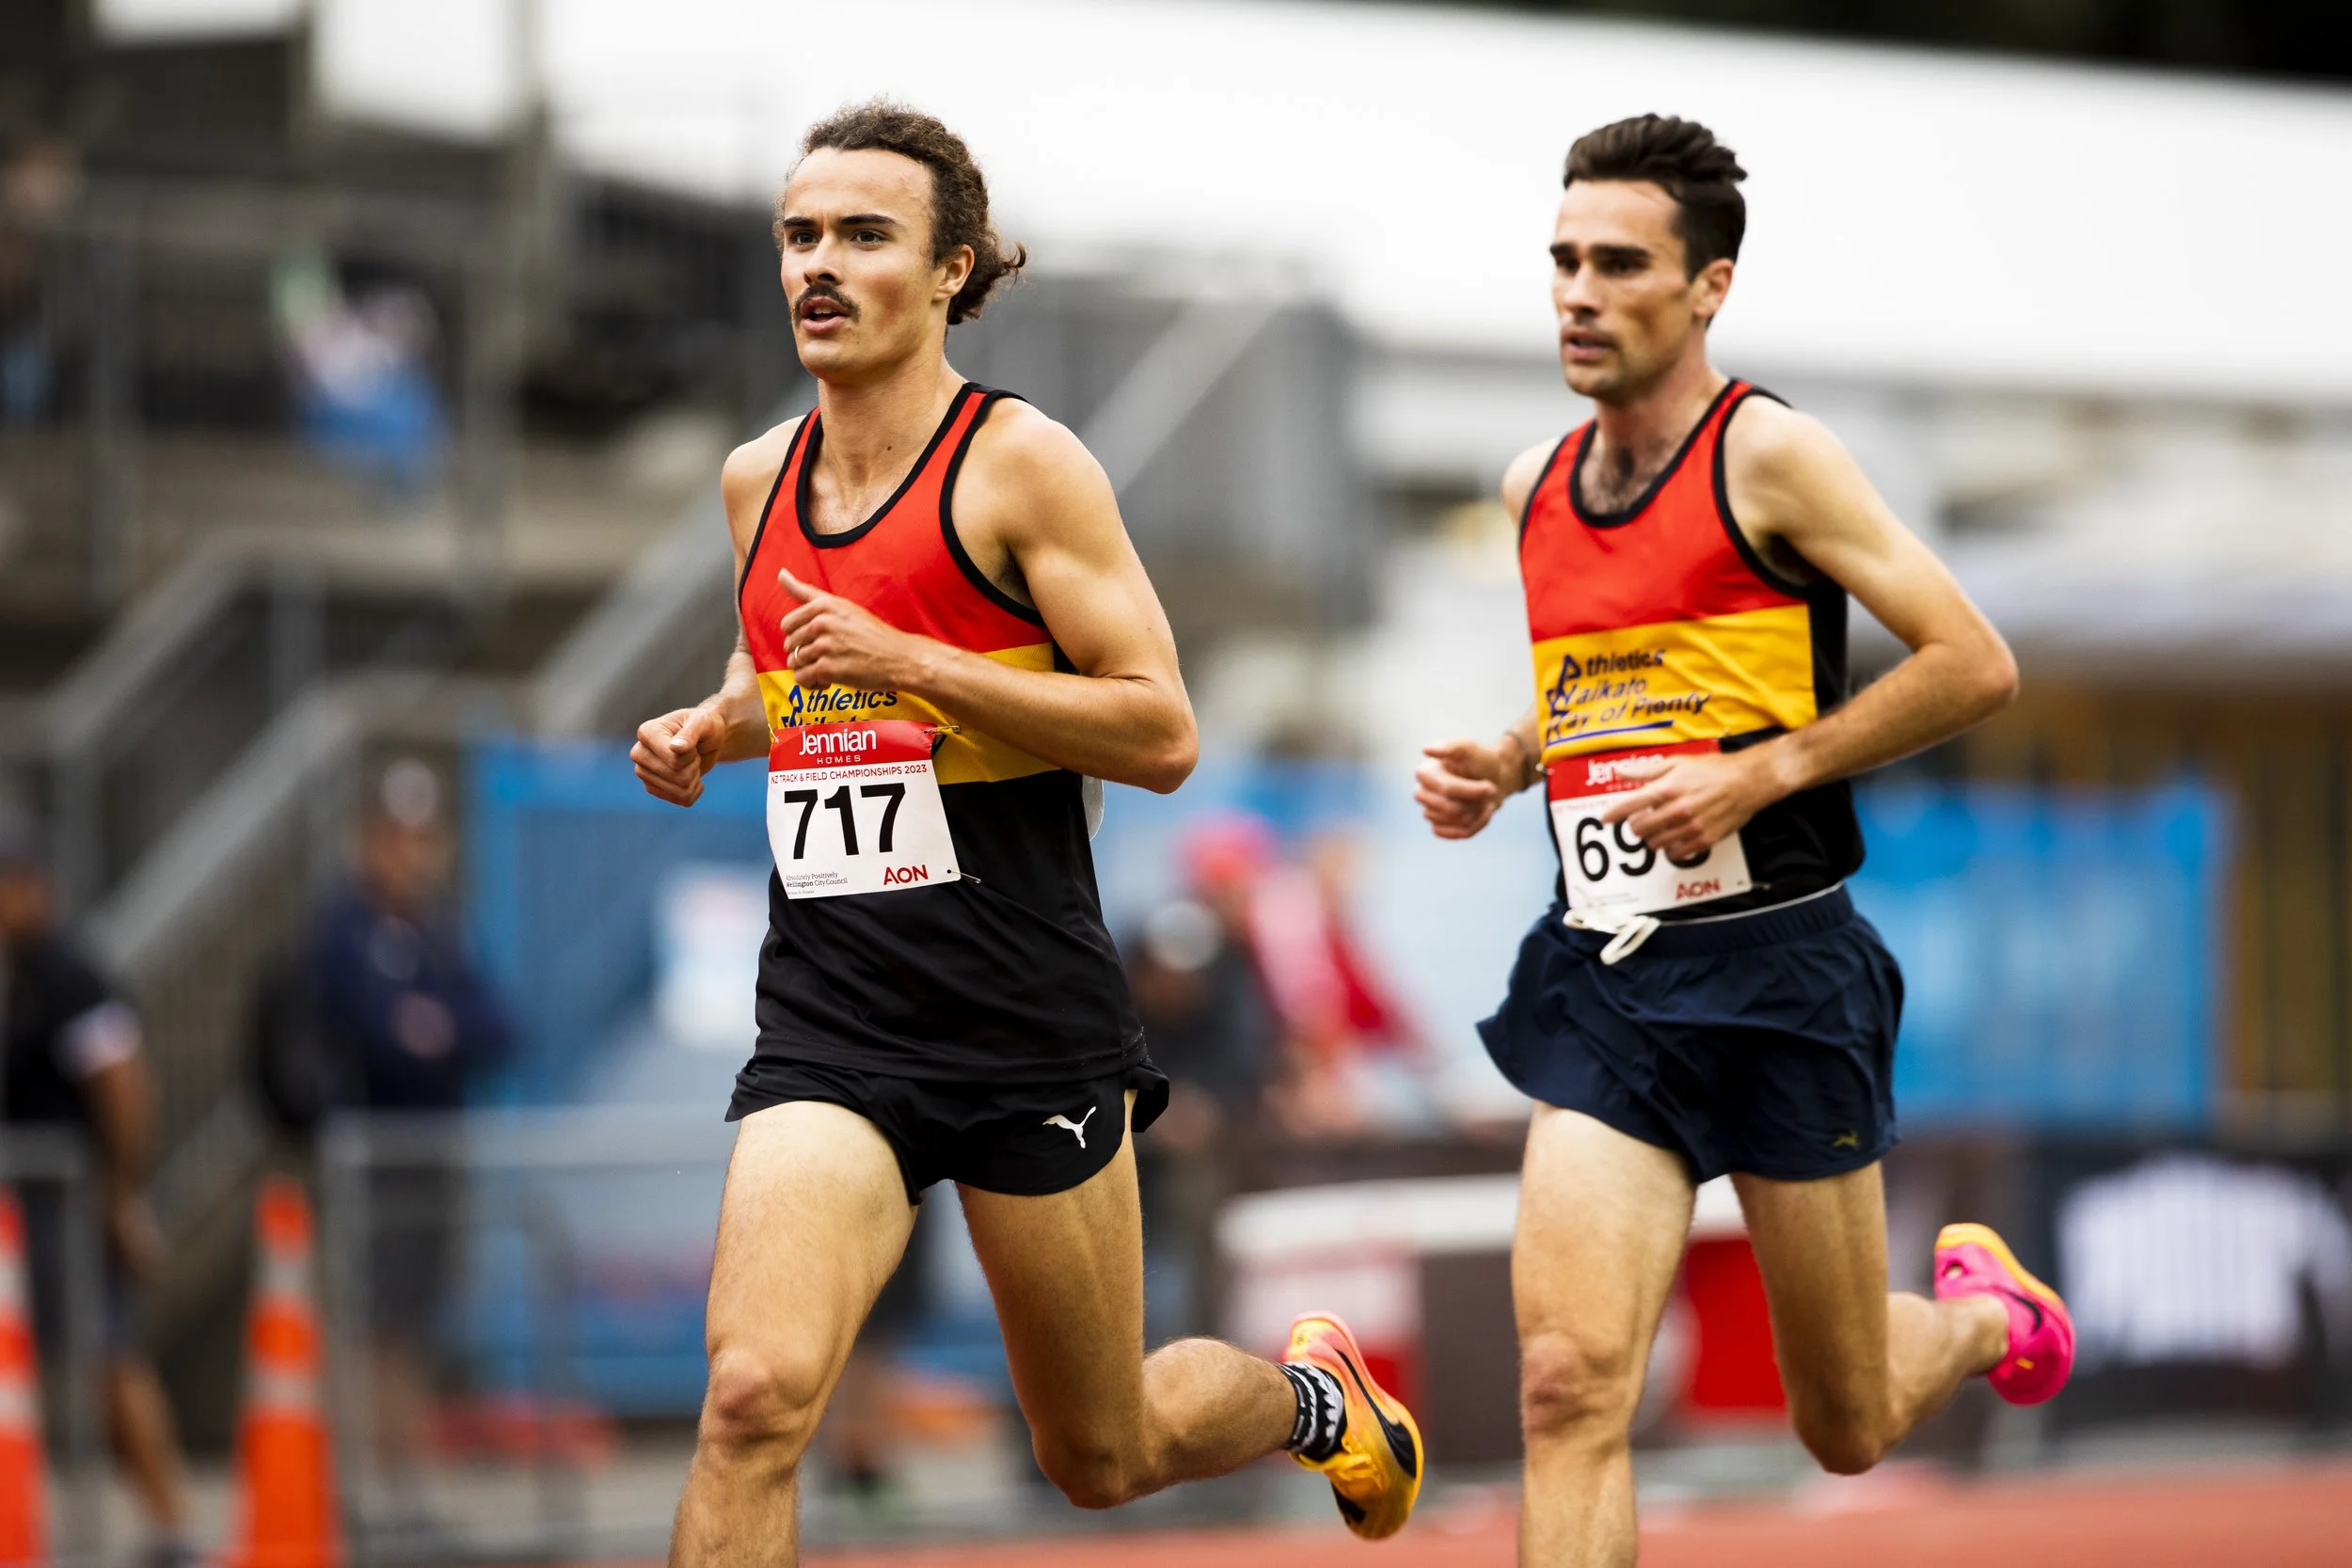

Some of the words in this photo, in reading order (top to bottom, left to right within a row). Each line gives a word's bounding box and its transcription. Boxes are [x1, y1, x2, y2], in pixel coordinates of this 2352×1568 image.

[1560, 648, 1666, 681] Athletics
[788, 685, 898, 713] Athletics
[799, 728, 877, 756] Jennian
[817, 754, 862, 765] HOMES
[779, 773, 798, 784] TRACK
[800, 773, 804, 782] &
[805, 770, 828, 782] FIELD
[830, 767, 902, 780] CHAMPIONSHIPS
[904, 764, 928, 774] 2023
[784, 783, 906, 860] 717
[811, 871, 838, 880] Positively
[883, 864, 929, 885] AON
[1676, 878, 1721, 899] AON
